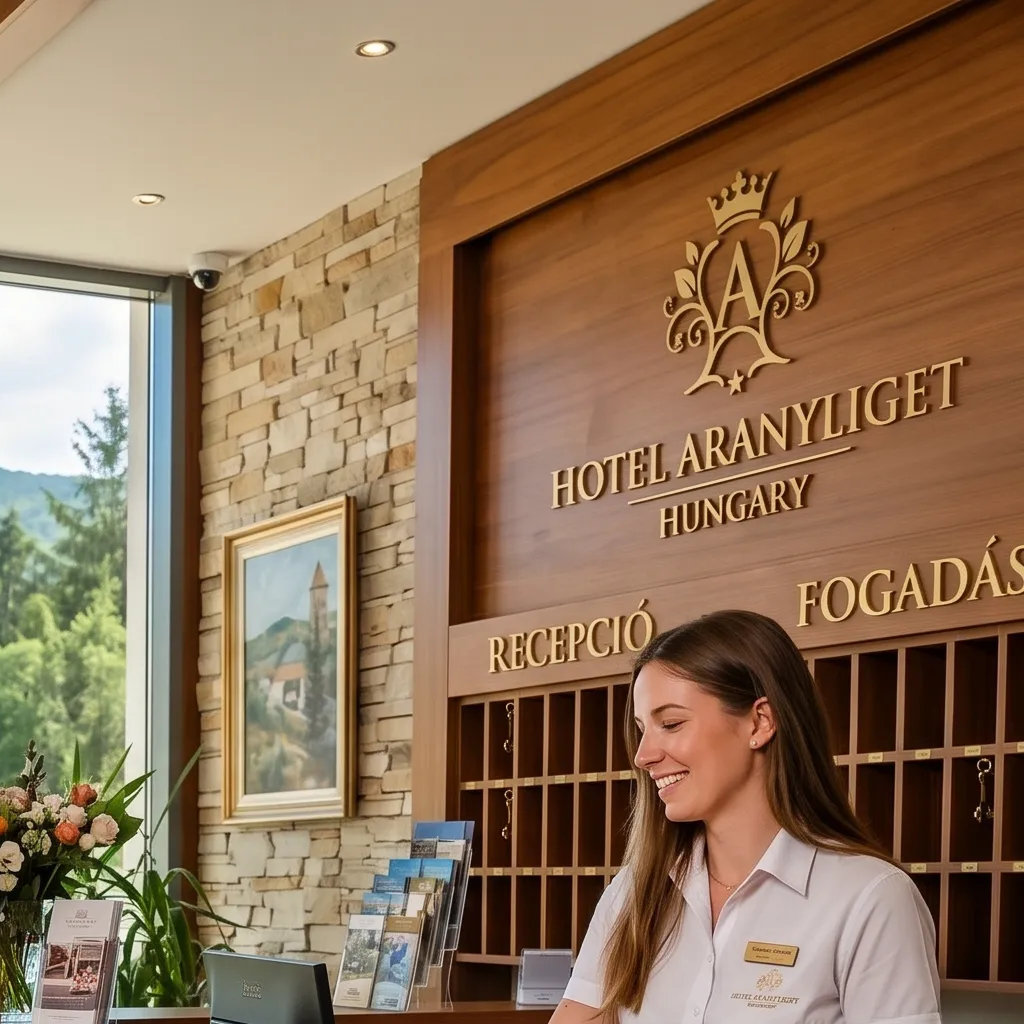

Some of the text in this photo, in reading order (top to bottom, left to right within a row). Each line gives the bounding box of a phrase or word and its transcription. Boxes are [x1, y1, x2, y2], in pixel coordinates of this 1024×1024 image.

[549, 355, 965, 510] HOTEL ARANYLIGET
[658, 473, 815, 539] HUNGARY
[795, 534, 1024, 628] FOGADÁS
[487, 598, 654, 674] RECEPCIÓ
